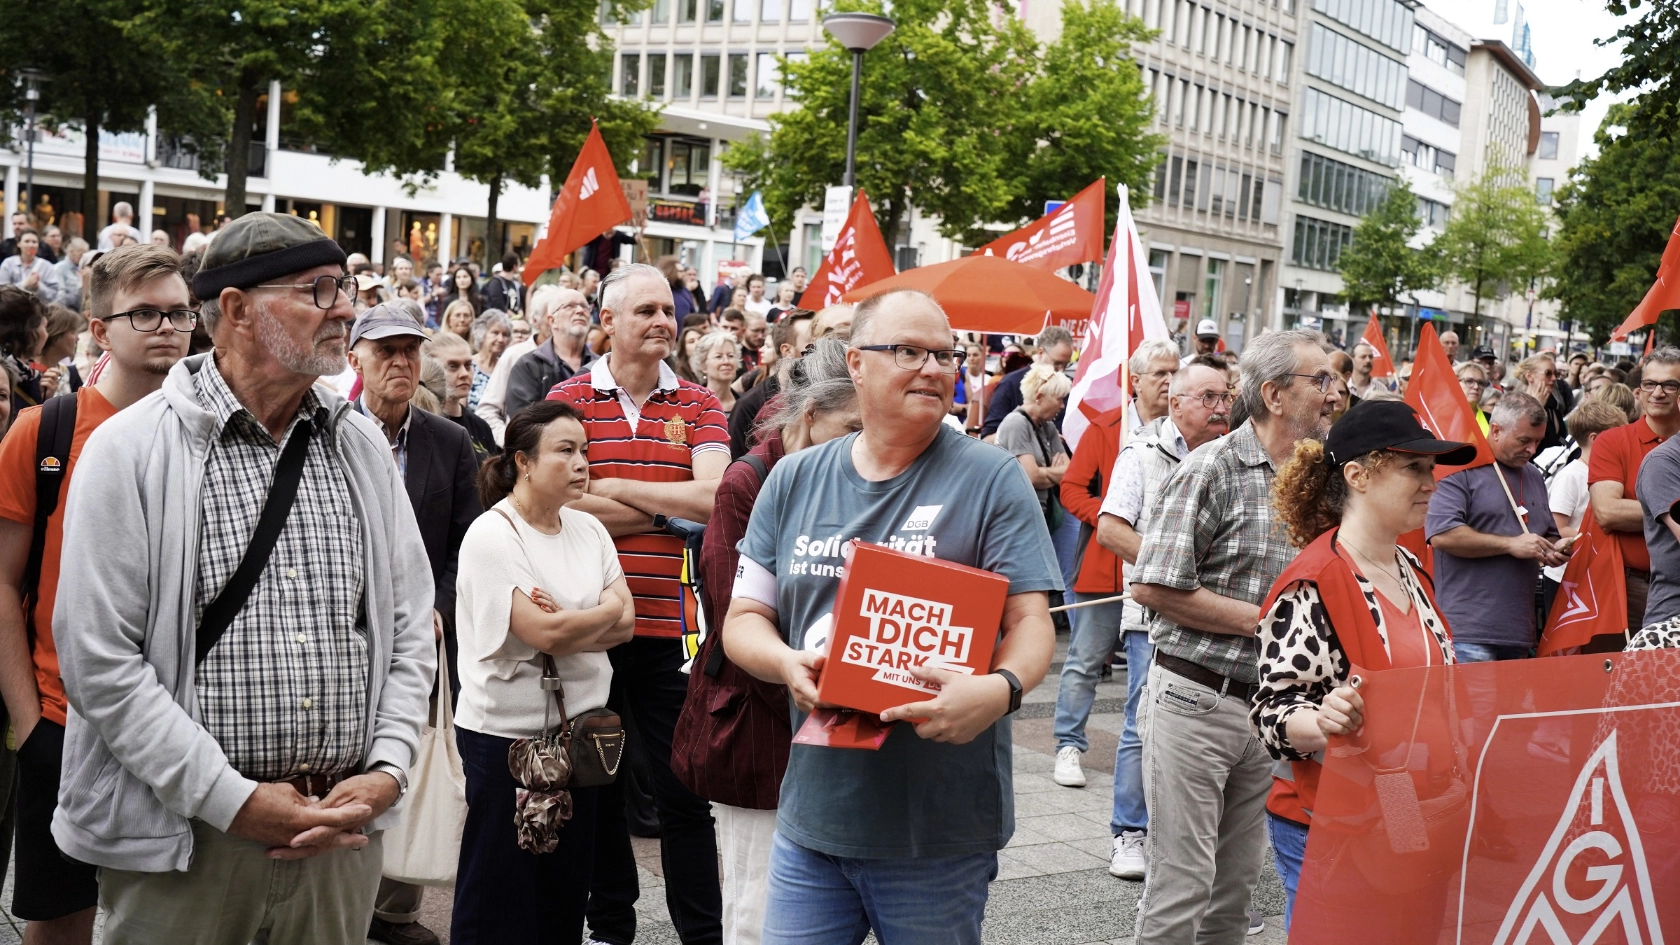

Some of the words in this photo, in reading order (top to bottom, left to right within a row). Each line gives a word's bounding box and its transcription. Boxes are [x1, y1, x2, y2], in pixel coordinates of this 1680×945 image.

[907, 520, 929, 529] DGB
[794, 534, 937, 559] Soliität
[789, 559, 808, 575] ist
[810, 563, 846, 578] uns
[866, 594, 945, 626] MACH
[876, 617, 965, 659] DICH
[848, 642, 930, 671] STARK
[883, 672, 900, 681] MIT
[902, 676, 921, 686] UNS
